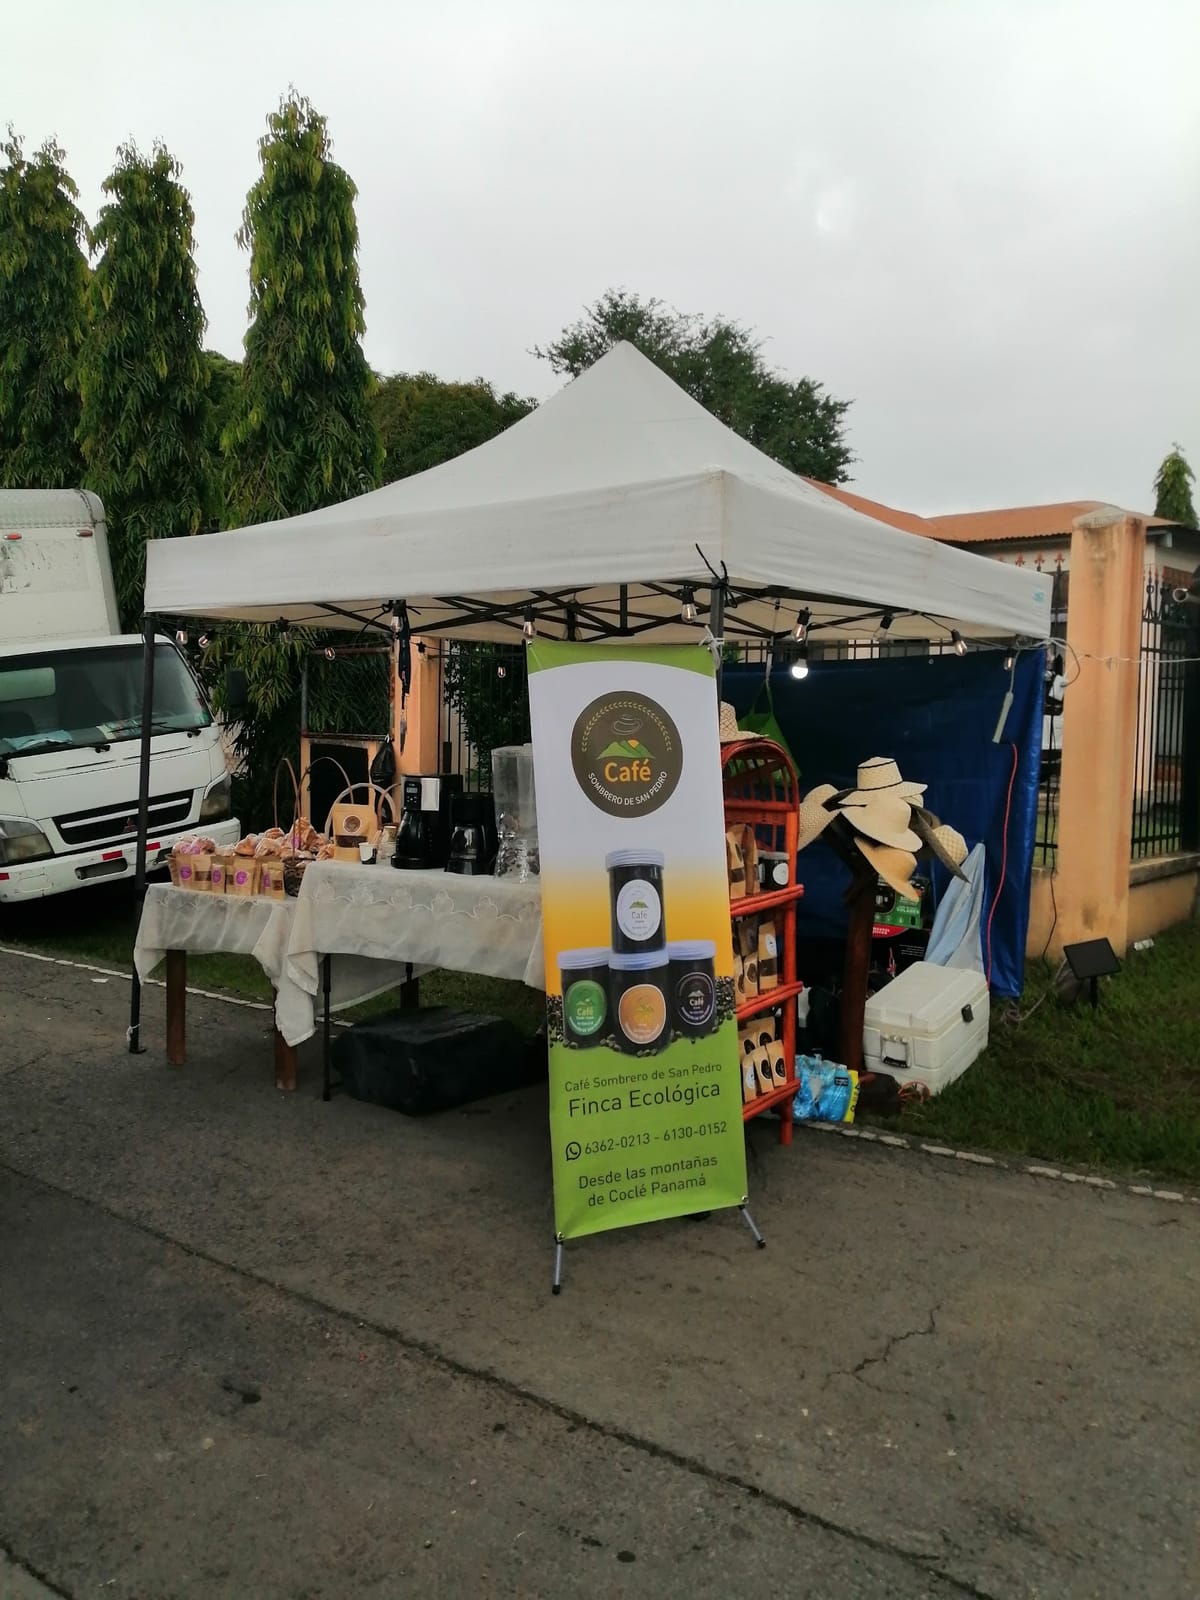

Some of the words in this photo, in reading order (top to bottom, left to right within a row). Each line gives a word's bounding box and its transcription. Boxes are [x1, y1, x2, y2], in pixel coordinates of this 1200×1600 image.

[604, 759, 651, 783] Café
[588, 772, 623, 805] SOMBRERO
[624, 797, 634, 806] DE
[635, 792, 651, 805] SAN
[649, 771, 668, 796] PEDRO
[564, 1078, 590, 1093] Café
[593, 1073, 649, 1088] Sombrero
[651, 1070, 665, 1080] de
[668, 1067, 689, 1079] San
[692, 1063, 722, 1075] Pedro
[569, 1097, 622, 1117] Finca
[629, 1083, 720, 1108] Ecológica
[584, 1132, 650, 1155] 6362-0213
[663, 1120, 727, 1142] 6130-0152
[579, 1171, 622, 1189] Desde
[626, 1167, 646, 1181] las
[650, 1155, 718, 1177] montañas
[588, 1193, 605, 1207] de
[609, 1184, 647, 1203] Coclé
[651, 1173, 707, 1196] Panamá
